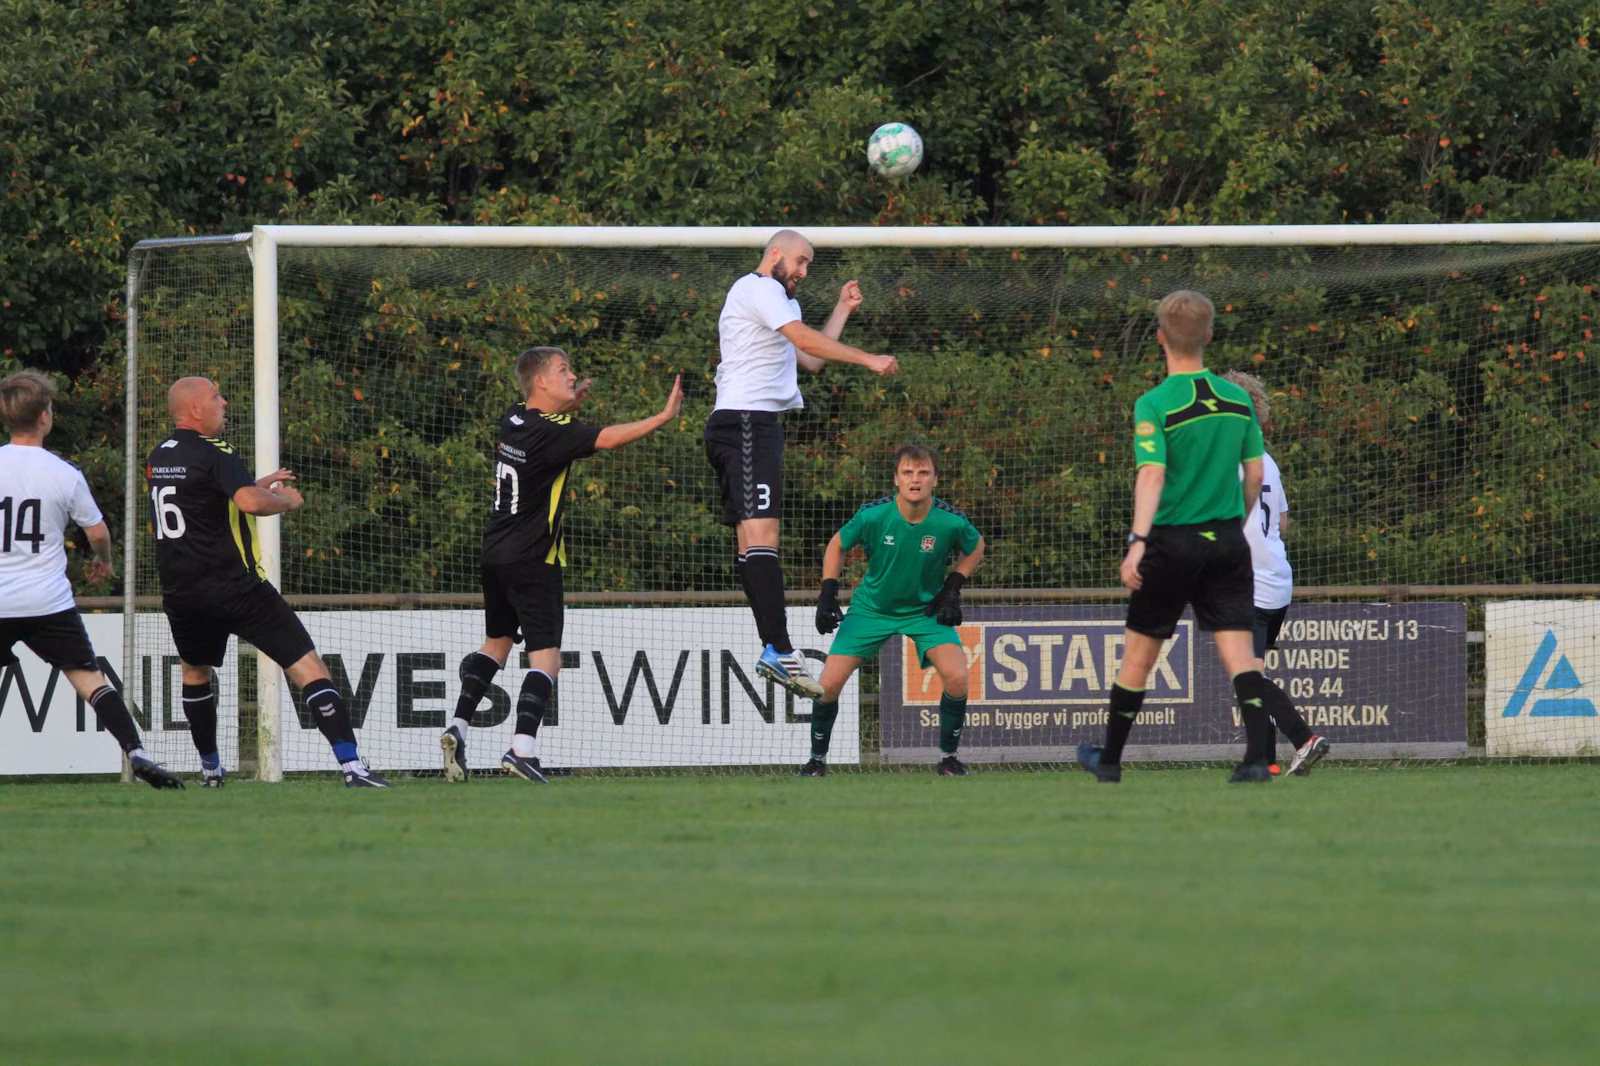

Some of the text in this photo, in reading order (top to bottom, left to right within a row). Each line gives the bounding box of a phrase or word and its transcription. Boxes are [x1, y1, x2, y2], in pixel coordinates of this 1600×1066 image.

[495, 461, 519, 515] 17
[756, 483, 771, 510] 3
[0, 496, 45, 553] 14
[151, 486, 186, 540] 16
[1395, 619, 1419, 640] 13
[1283, 648, 1350, 670] VARDE
[1289, 677, 1314, 699] 03
[1318, 677, 1344, 698] 44
[995, 708, 1050, 730] bygger
[1053, 708, 1067, 726] vi
[1072, 707, 1176, 730] profeonelt
